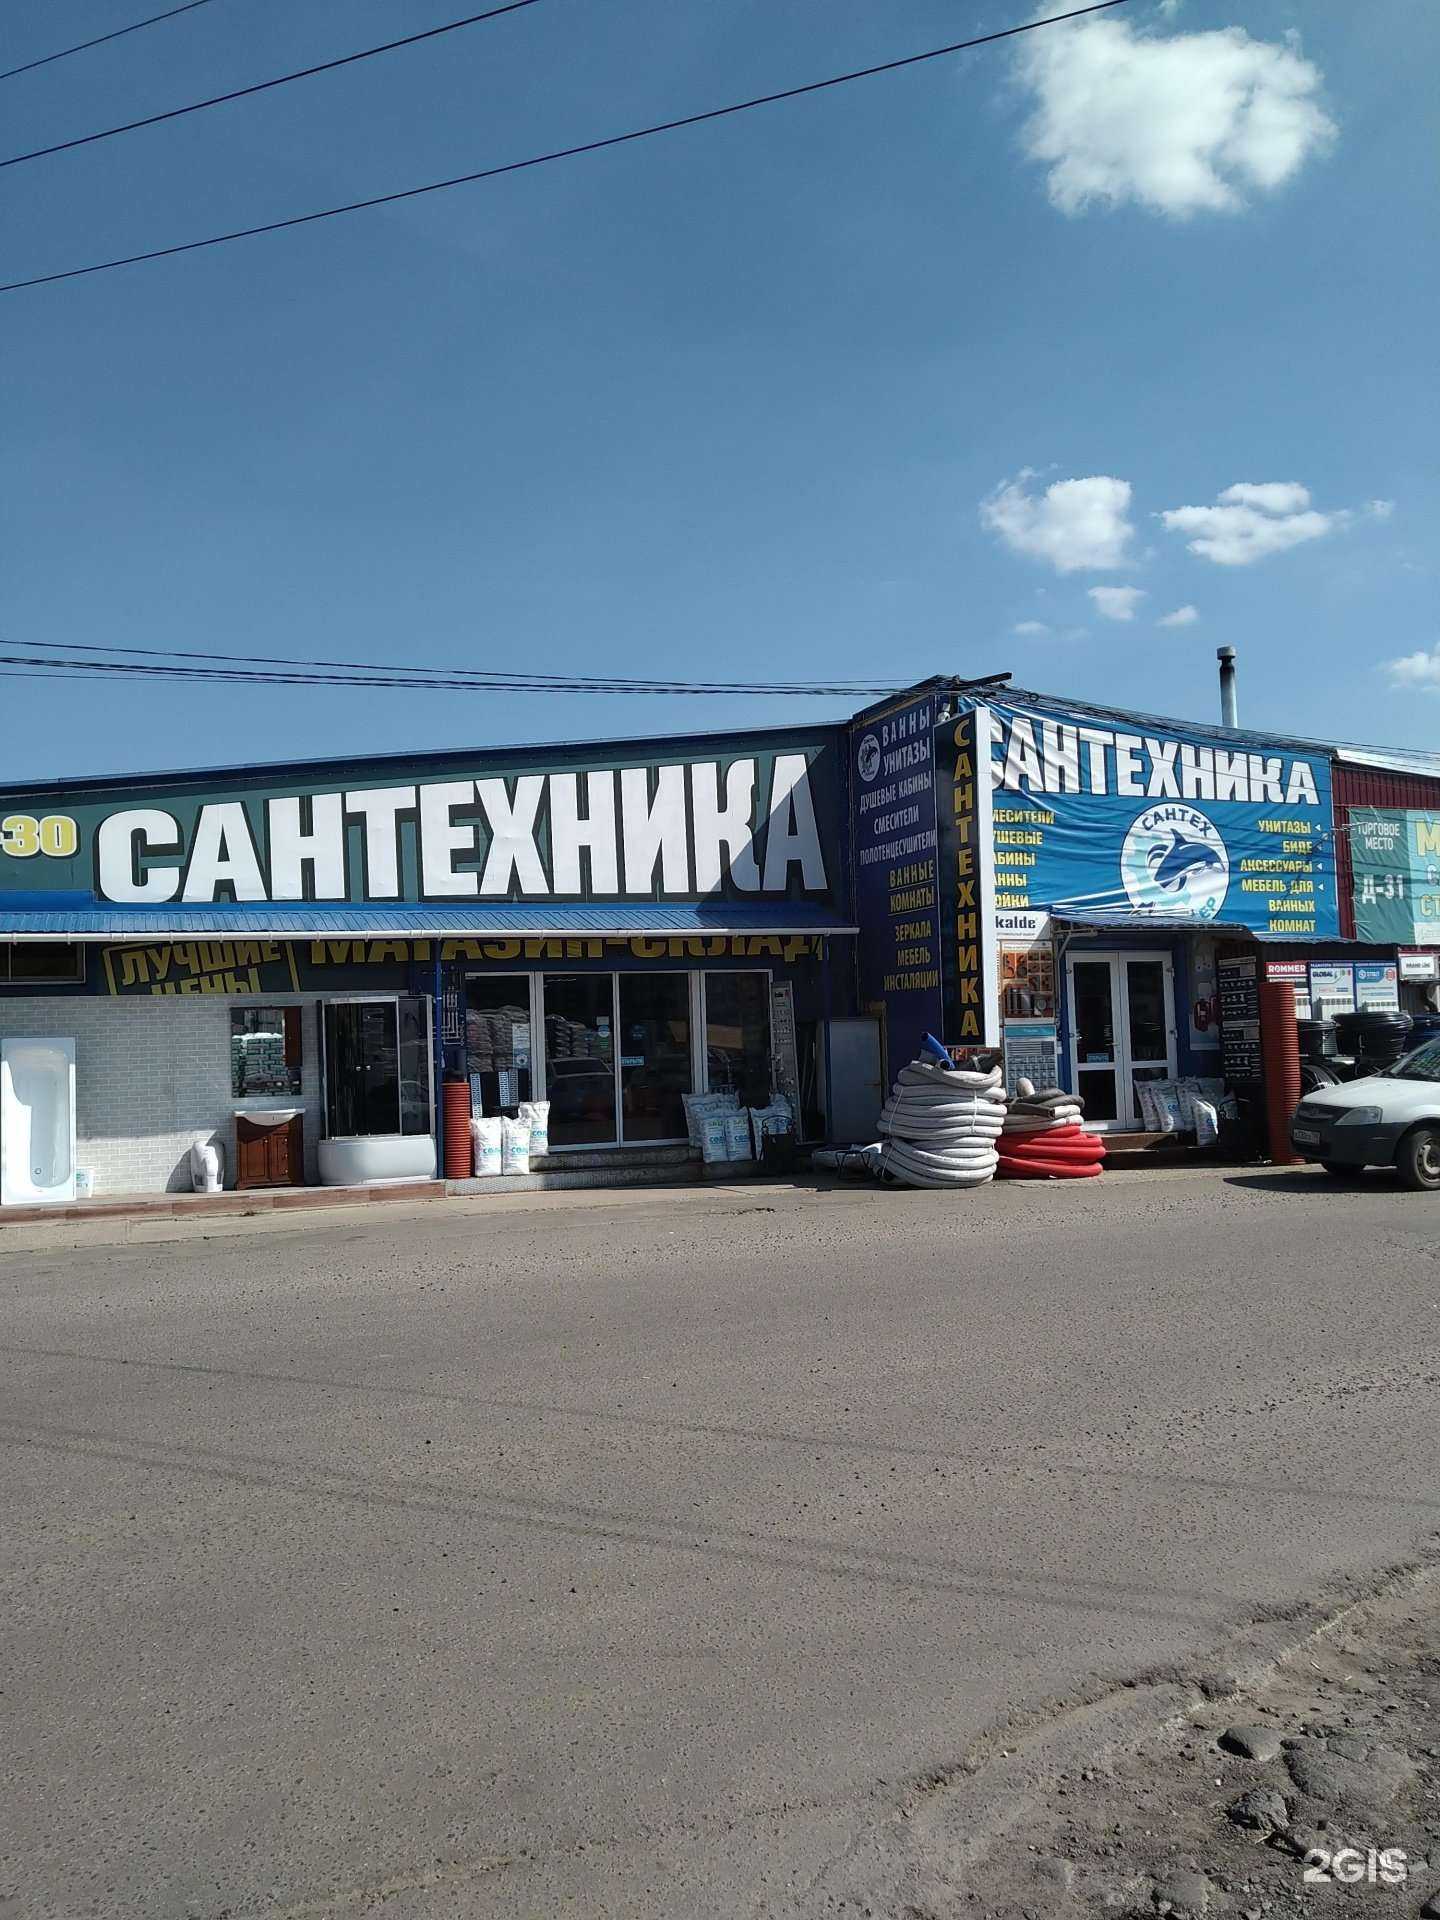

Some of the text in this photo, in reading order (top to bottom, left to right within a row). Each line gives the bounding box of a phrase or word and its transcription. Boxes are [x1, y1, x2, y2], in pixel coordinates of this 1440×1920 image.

[882, 706, 931, 747] ВАННЫ
[883, 736, 931, 777] УНИТАЗЫ
[860, 771, 932, 816] ДУШЕВЫЕ КАБИНЫ
[873, 804, 920, 835] СМЕСИТЕЛИ
[992, 809, 1055, 824] МЕСИТЕЛИ
[1141, 807, 1213, 838] САНТЕХ
[1258, 820, 1312, 835] УНИТАЗЫ
[99, 753, 829, 903] САНТЕХНИКА
[1357, 822, 1400, 837] ТОРГОВОЕ
[859, 829, 937, 866] ПОЛОТЕНЦЕСУШИТЕЛИ
[1282, 840, 1313, 855] БИДЕ
[1365, 837, 1394, 851] МЕСТО
[993, 851, 1036, 866] АБИНЫ
[1240, 858, 1313, 873] АКСЕССУАРЫ
[889, 860, 934, 888] ВАННЫЕ
[953, 718, 980, 1037] САНТЕХНИКА
[1241, 879, 1314, 894] МЕБЕЛЬ ДЛЯ
[1362, 873, 1404, 904] Д-31
[890, 885, 935, 913] КОМНАТЫ
[994, 892, 1029, 908] ОЙКИ
[1268, 899, 1315, 913] ВАННЫХ
[895, 919, 932, 943] ЗЕРКАЛА
[995, 915, 1036, 929] kalde
[1269, 919, 1315, 932] КОМНАТ
[121, 941, 282, 986] ЛУЧШИЕ
[897, 946, 931, 967] МЕБЕЛЬ
[1268, 964, 1307, 973] ROMMER
[883, 970, 939, 993] ИНСТАЛЯЦИИ
